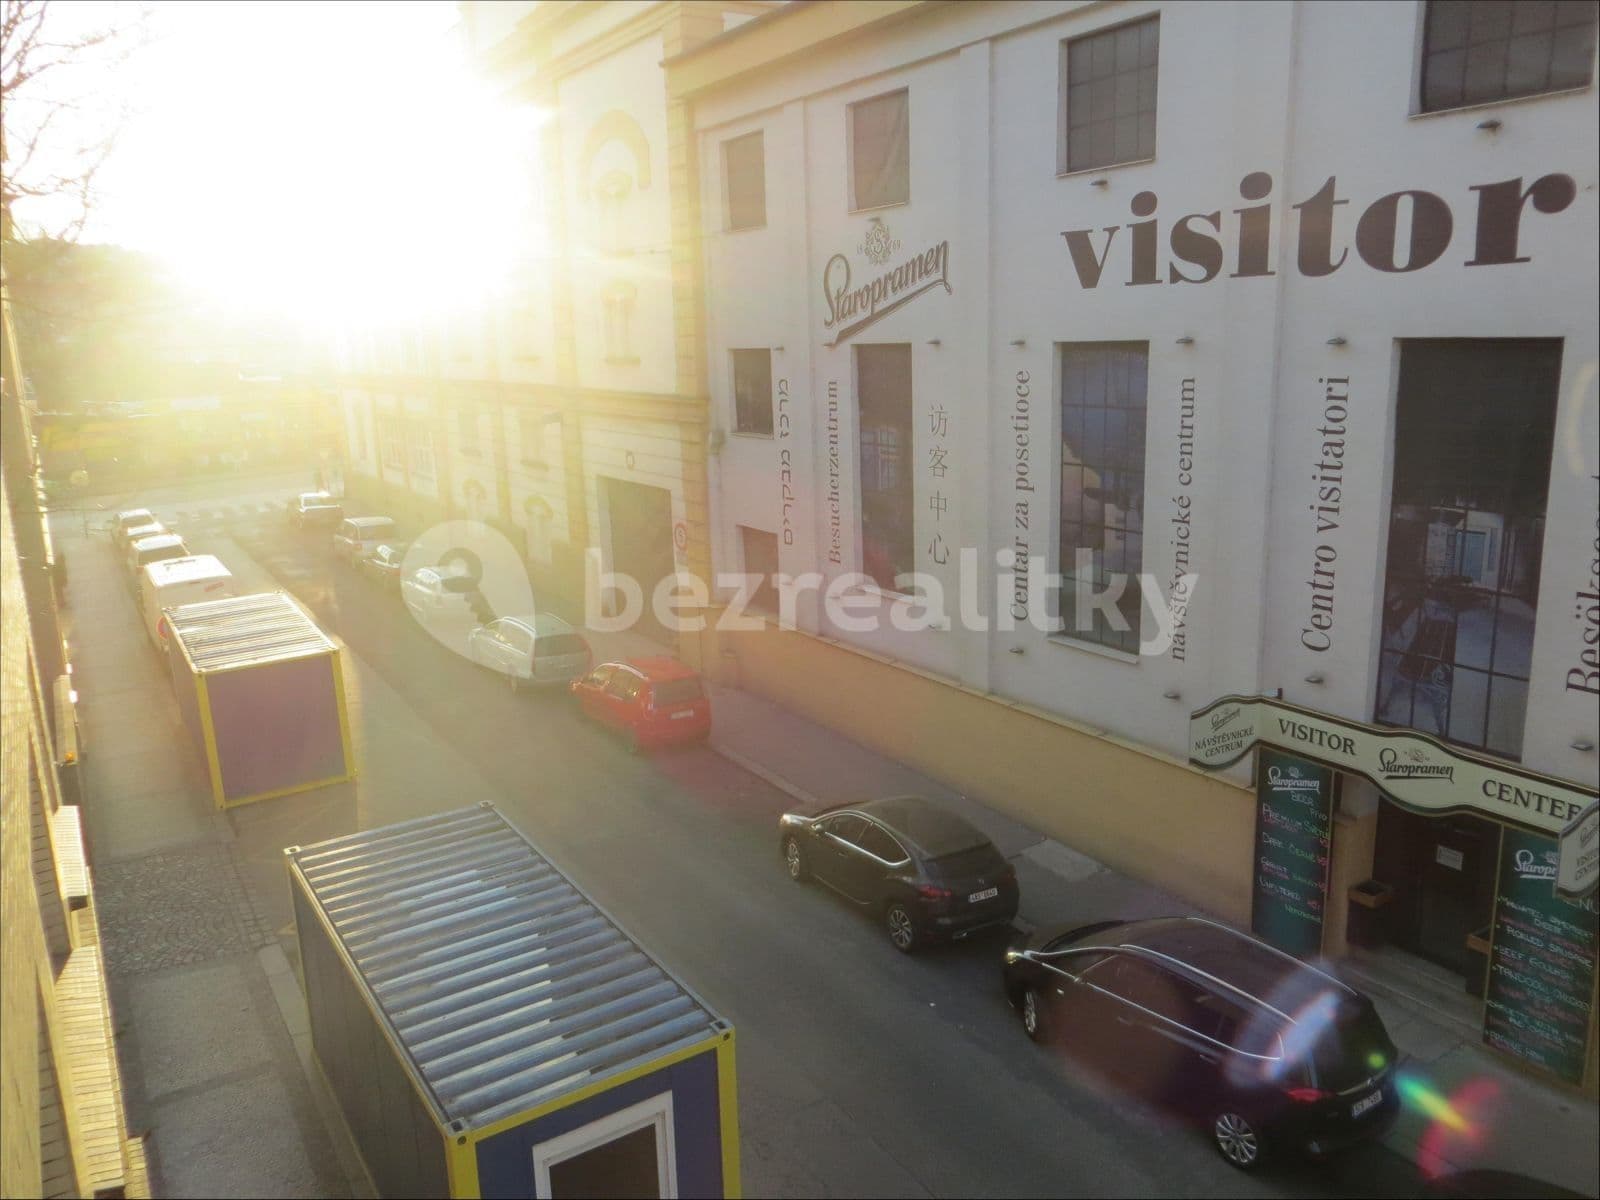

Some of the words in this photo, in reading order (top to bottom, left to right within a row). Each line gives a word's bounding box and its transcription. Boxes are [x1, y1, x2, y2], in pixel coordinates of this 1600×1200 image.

[1060, 171, 1577, 289] visitor
[823, 240, 952, 344] Staropramen
[827, 379, 842, 566] Besucherzentrum
[928, 403, 950, 566] 访客中心
[1010, 369, 1035, 493] posetioce
[1177, 376, 1196, 486] centrum
[1310, 375, 1350, 534] visitatori
[1016, 500, 1030, 530] za
[1010, 536, 1030, 622] Centar
[1169, 494, 1192, 663] návštěvnické
[1301, 544, 1337, 652] Centro
[1204, 740, 1244, 758] CENTRUM
[1268, 766, 1320, 794] Staropramen
[1278, 718, 1357, 756] VISITOR
[1378, 747, 1455, 784] Staropramen
